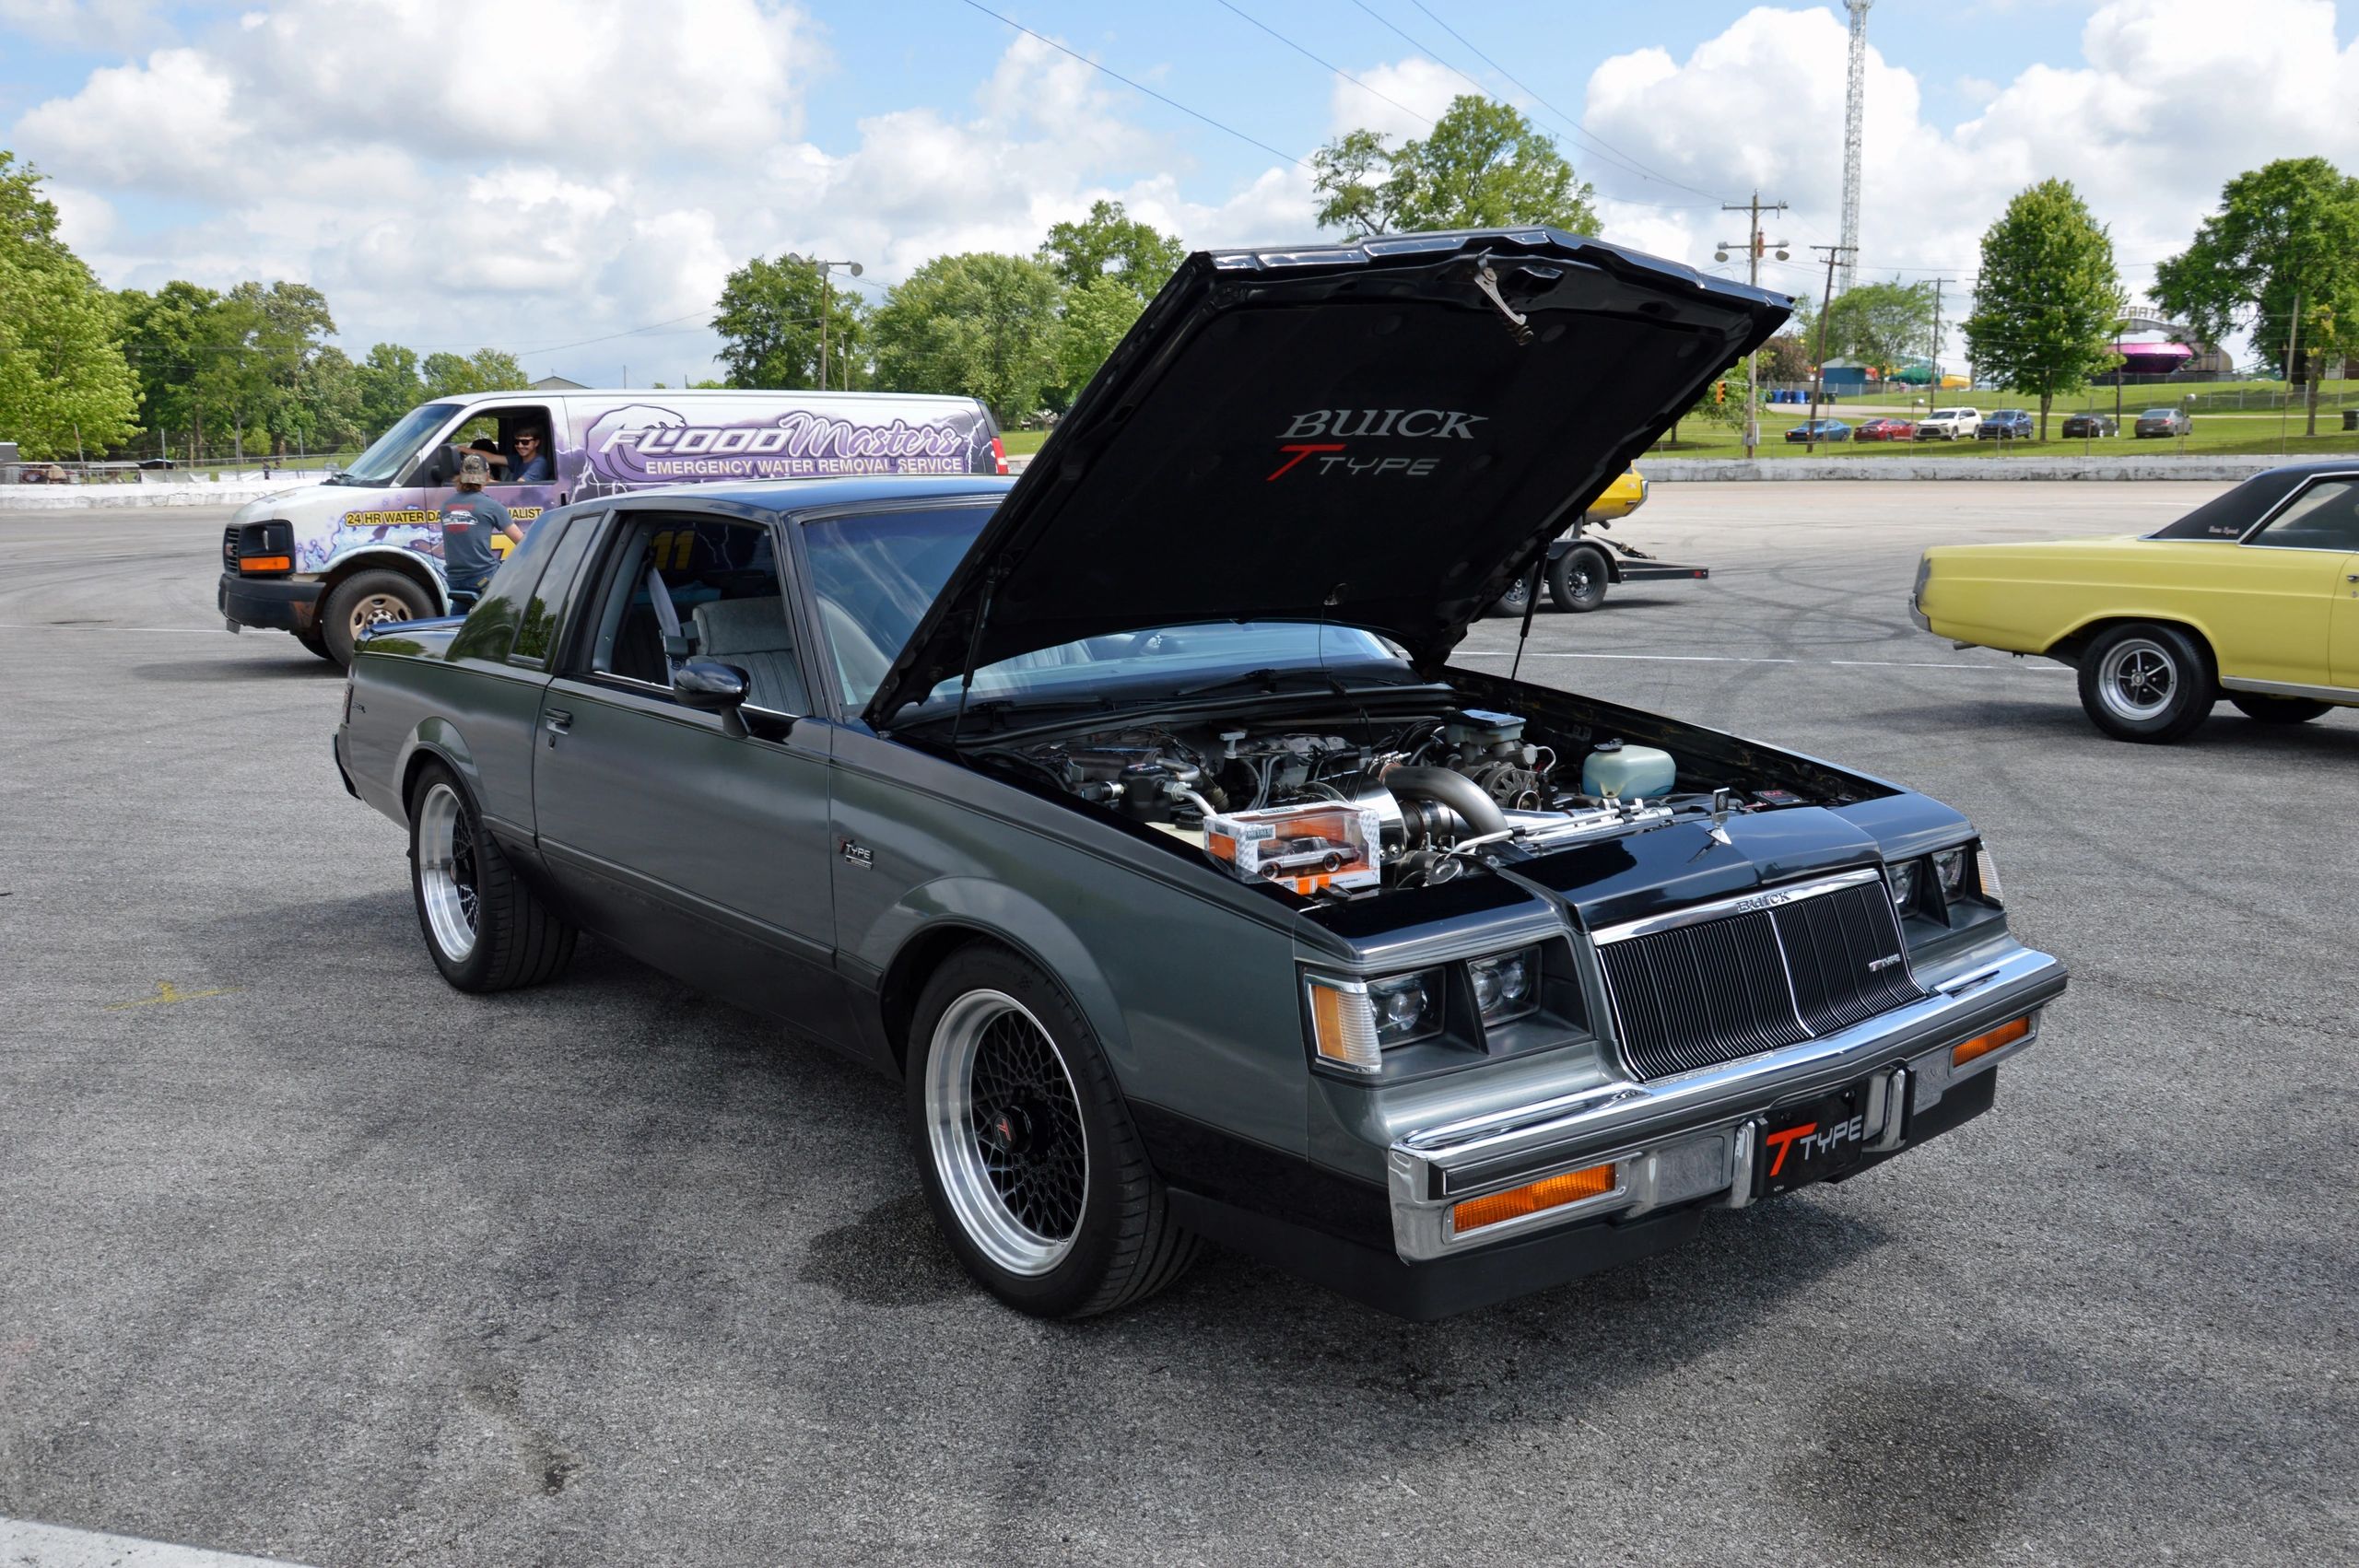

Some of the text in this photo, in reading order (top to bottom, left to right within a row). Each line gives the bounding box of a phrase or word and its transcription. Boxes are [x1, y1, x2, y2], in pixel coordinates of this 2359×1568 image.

[598, 411, 964, 459] FLOOD Masters
[1275, 409, 1489, 439] BUICK
[646, 458, 963, 475] EMERGENCY WATER REMOVAL SERVICE
[1266, 444, 1440, 482] T TYPE
[346, 513, 361, 524] 24
[364, 513, 381, 523] HR
[384, 511, 425, 522] WATER
[846, 843, 871, 860] TYPE
[1737, 891, 1790, 911] BUICK
[1766, 1114, 1862, 1176] T TYPE
